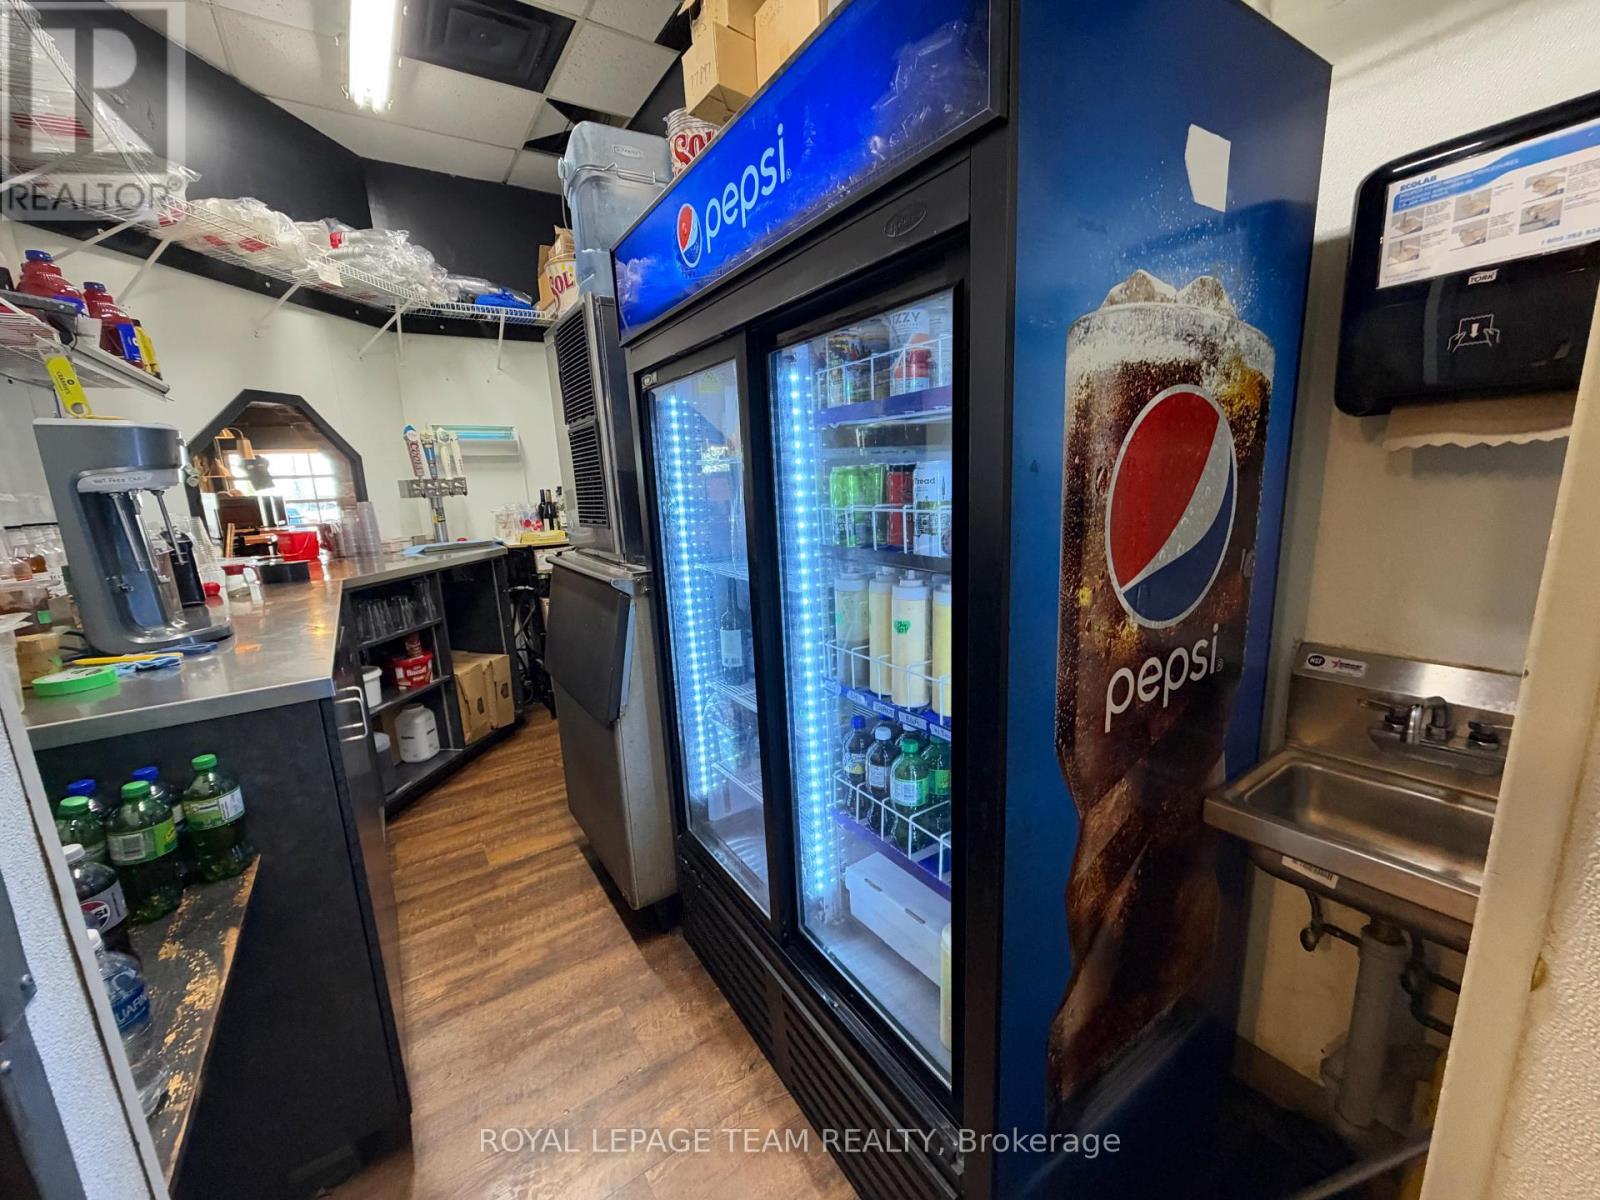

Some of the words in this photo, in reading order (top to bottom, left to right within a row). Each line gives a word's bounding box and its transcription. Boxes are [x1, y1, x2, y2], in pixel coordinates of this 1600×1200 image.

[705, 122, 787, 255] pepsi
[1400, 175, 1438, 191] ECOLAB
[1470, 271, 1496, 284] TORK
[1103, 623, 1220, 734] pepsi
